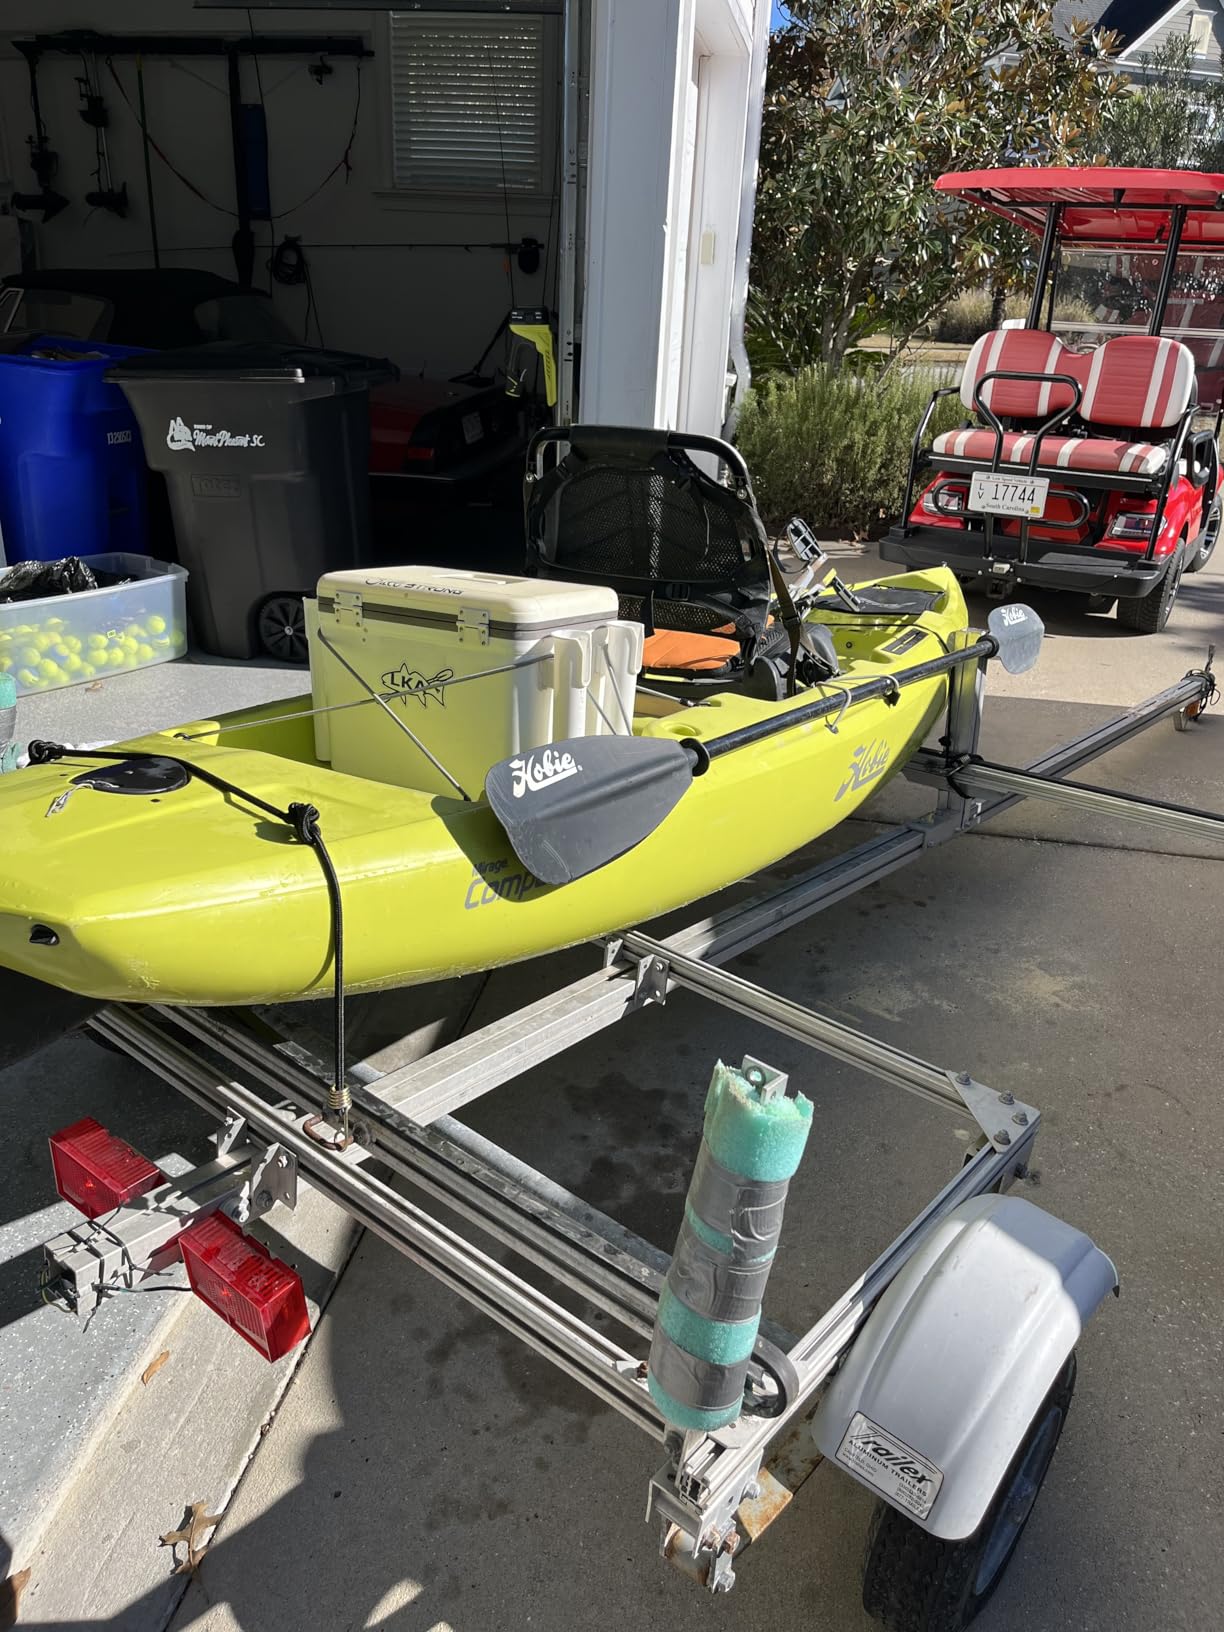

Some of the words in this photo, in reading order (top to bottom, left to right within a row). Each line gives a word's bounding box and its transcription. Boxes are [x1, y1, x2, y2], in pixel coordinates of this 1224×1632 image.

[250, 434, 265, 447] SC
[992, 483, 1036, 504] 17744
[1002, 504, 1025, 512] Carolina
[1001, 607, 1026, 627] Hobie
[509, 749, 579, 798] Hobie
[834, 737, 890, 802] Hobie
[472, 859, 508, 877] Mirage
[464, 872, 545, 910] Comp
[849, 1439, 889, 1470] ALUMINUM
[891, 1468, 927, 1497] TRAILERS
[850, 1425, 937, 1484] Trailex
